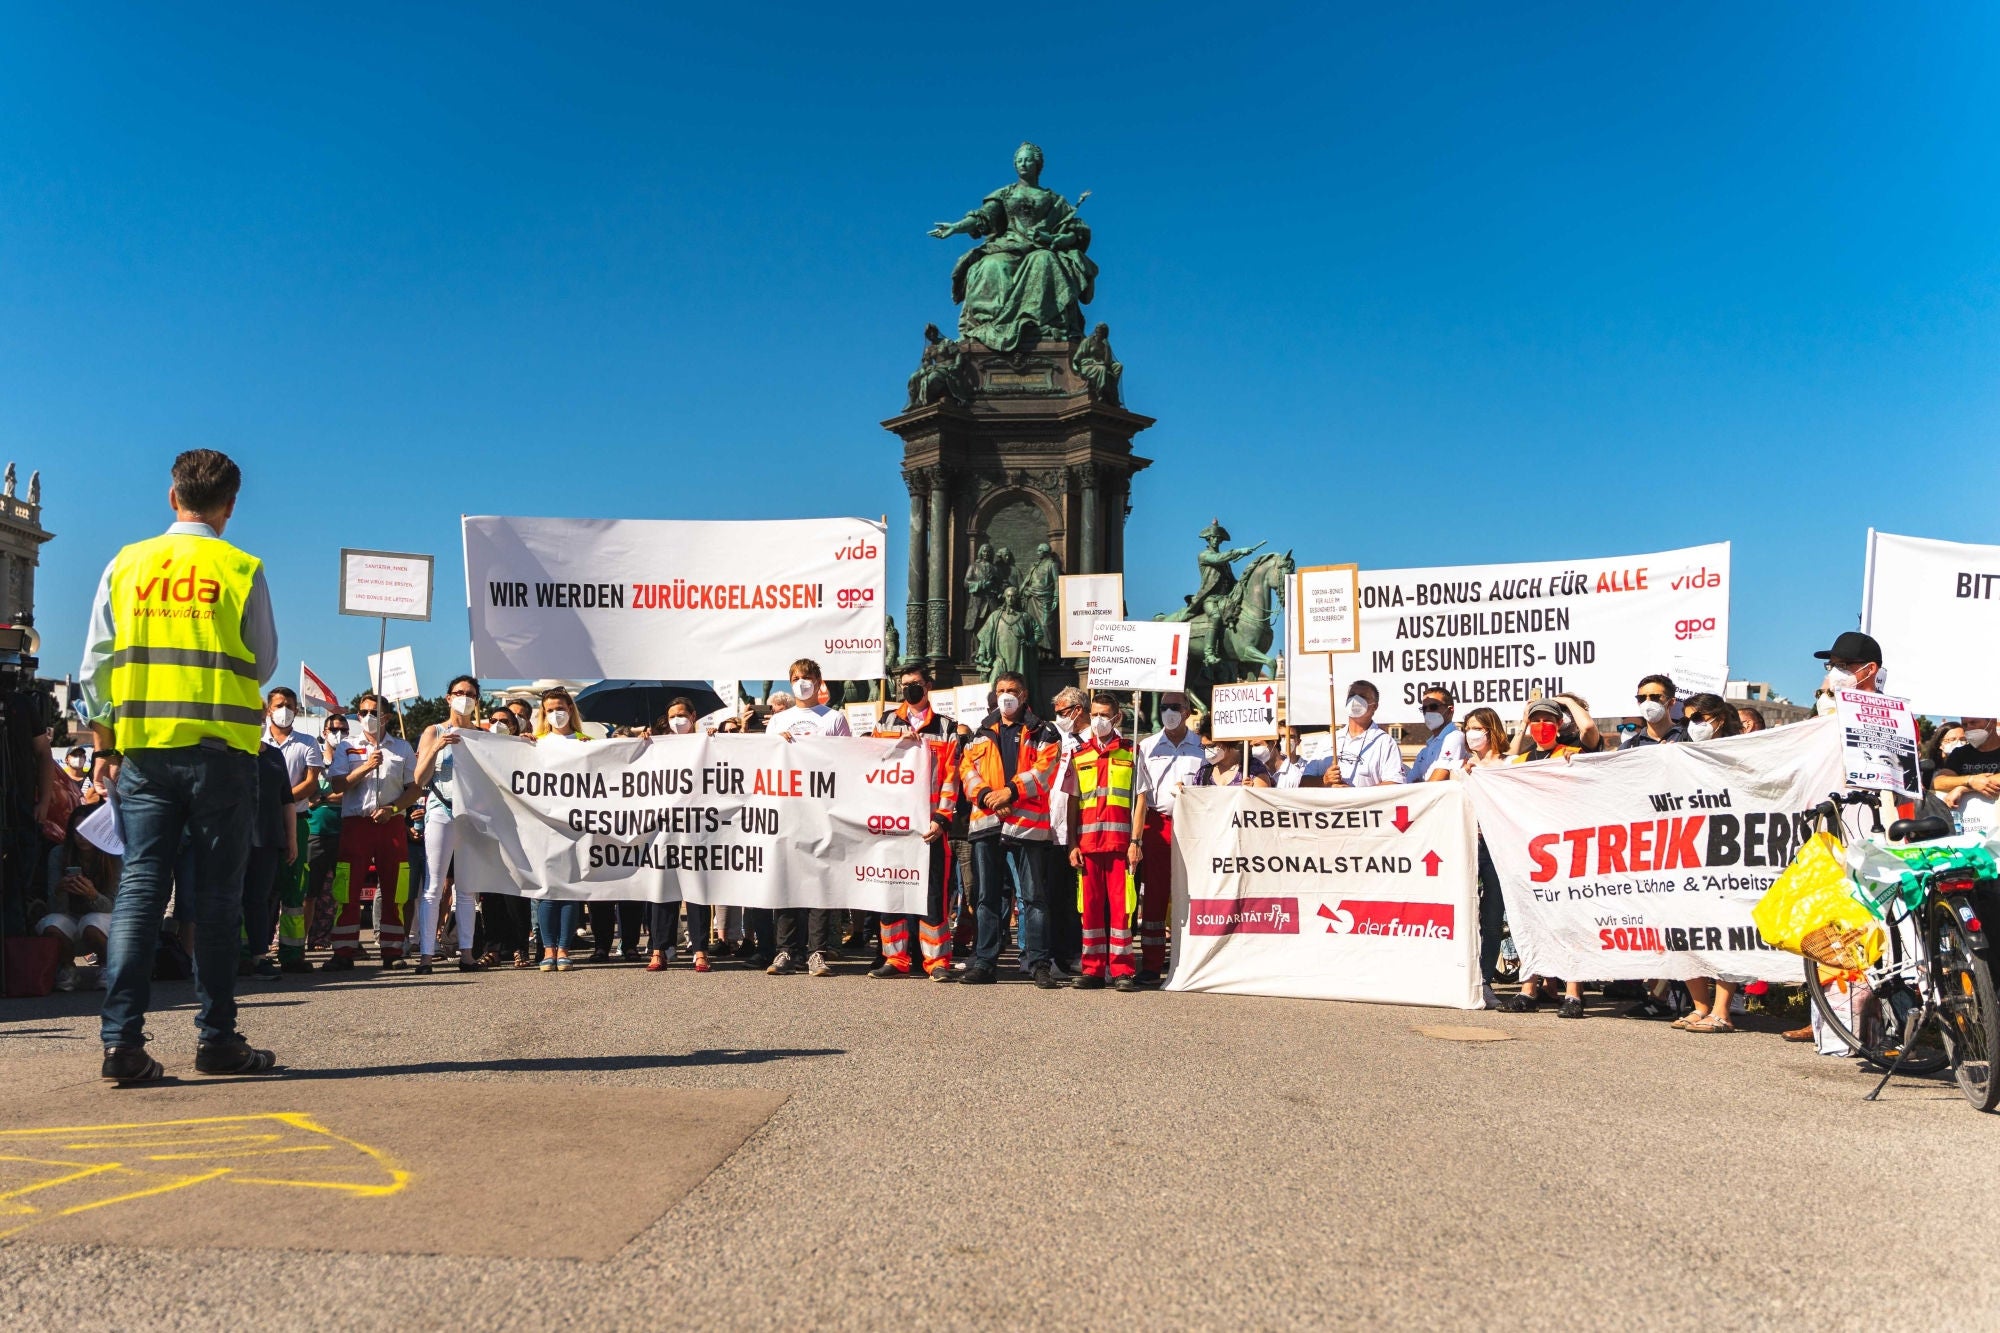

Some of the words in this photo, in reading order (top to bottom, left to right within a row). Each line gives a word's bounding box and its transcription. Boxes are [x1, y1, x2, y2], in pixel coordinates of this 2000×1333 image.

[835, 535, 877, 560] vida
[136, 559, 221, 604] vida
[1489, 577, 1542, 601] AUCH
[1550, 571, 1588, 597] FÜR
[1596, 568, 1648, 594] ALLE
[1671, 565, 1721, 591] vida
[1956, 572, 2000, 600] BIT
[490, 581, 529, 608] WIR
[535, 582, 624, 609] WERDEN
[632, 579, 823, 609] ZURÜCKGELASSEN!
[837, 588, 874, 609] gpa
[134, 606, 216, 620] www.vida.at
[1396, 607, 1570, 640] AUSZUBILDENDEN
[1093, 634, 1115, 642] OHNE
[1675, 617, 1715, 640] gpa
[825, 638, 882, 654] younion
[1092, 645, 1134, 653] RETTUNGS-
[1372, 650, 1394, 673] IM
[1402, 643, 1547, 672] GESUNDHEITS-
[1555, 640, 1596, 665] UND
[1090, 667, 1112, 675] NICHT
[1091, 657, 1156, 665] ORGANISATIONEN
[1089, 679, 1130, 687] ABSEHBAR
[1214, 688, 1261, 703] PERSONAL
[1844, 692, 1902, 709] GESUNDHEIT
[1214, 707, 1265, 725] ARBEITSZEIT
[1859, 715, 1897, 728] PROFIT!
[1861, 705, 1888, 717] STATT
[511, 768, 693, 799] CORONA-BONUS
[702, 761, 745, 795] FÜR
[753, 768, 803, 797] ALLE
[810, 771, 836, 799] IM
[865, 757, 915, 785] vida
[1649, 793, 1682, 812] Wir
[1688, 788, 1732, 809] sind
[568, 806, 732, 836] GESUNDHEITS-
[740, 807, 779, 836] UND
[867, 815, 910, 836] gpa
[1231, 810, 1383, 830] ARBEITSZEIT
[589, 843, 763, 873] SOZIALBEREICH!
[1212, 856, 1412, 874] PERSONALSTAND
[855, 865, 920, 882] younion
[1533, 888, 1560, 902] Für
[1568, 879, 1632, 900] höhere
[1636, 879, 1675, 894] Löhne
[1683, 877, 1700, 892] &
[1196, 911, 1262, 926] SOLIDARITÄT
[1357, 917, 1388, 936] der
[1387, 918, 1450, 940] funke
[1594, 915, 1619, 927] Wir
[1622, 914, 1644, 926] sind
[1598, 927, 1665, 951] SOZIAL
